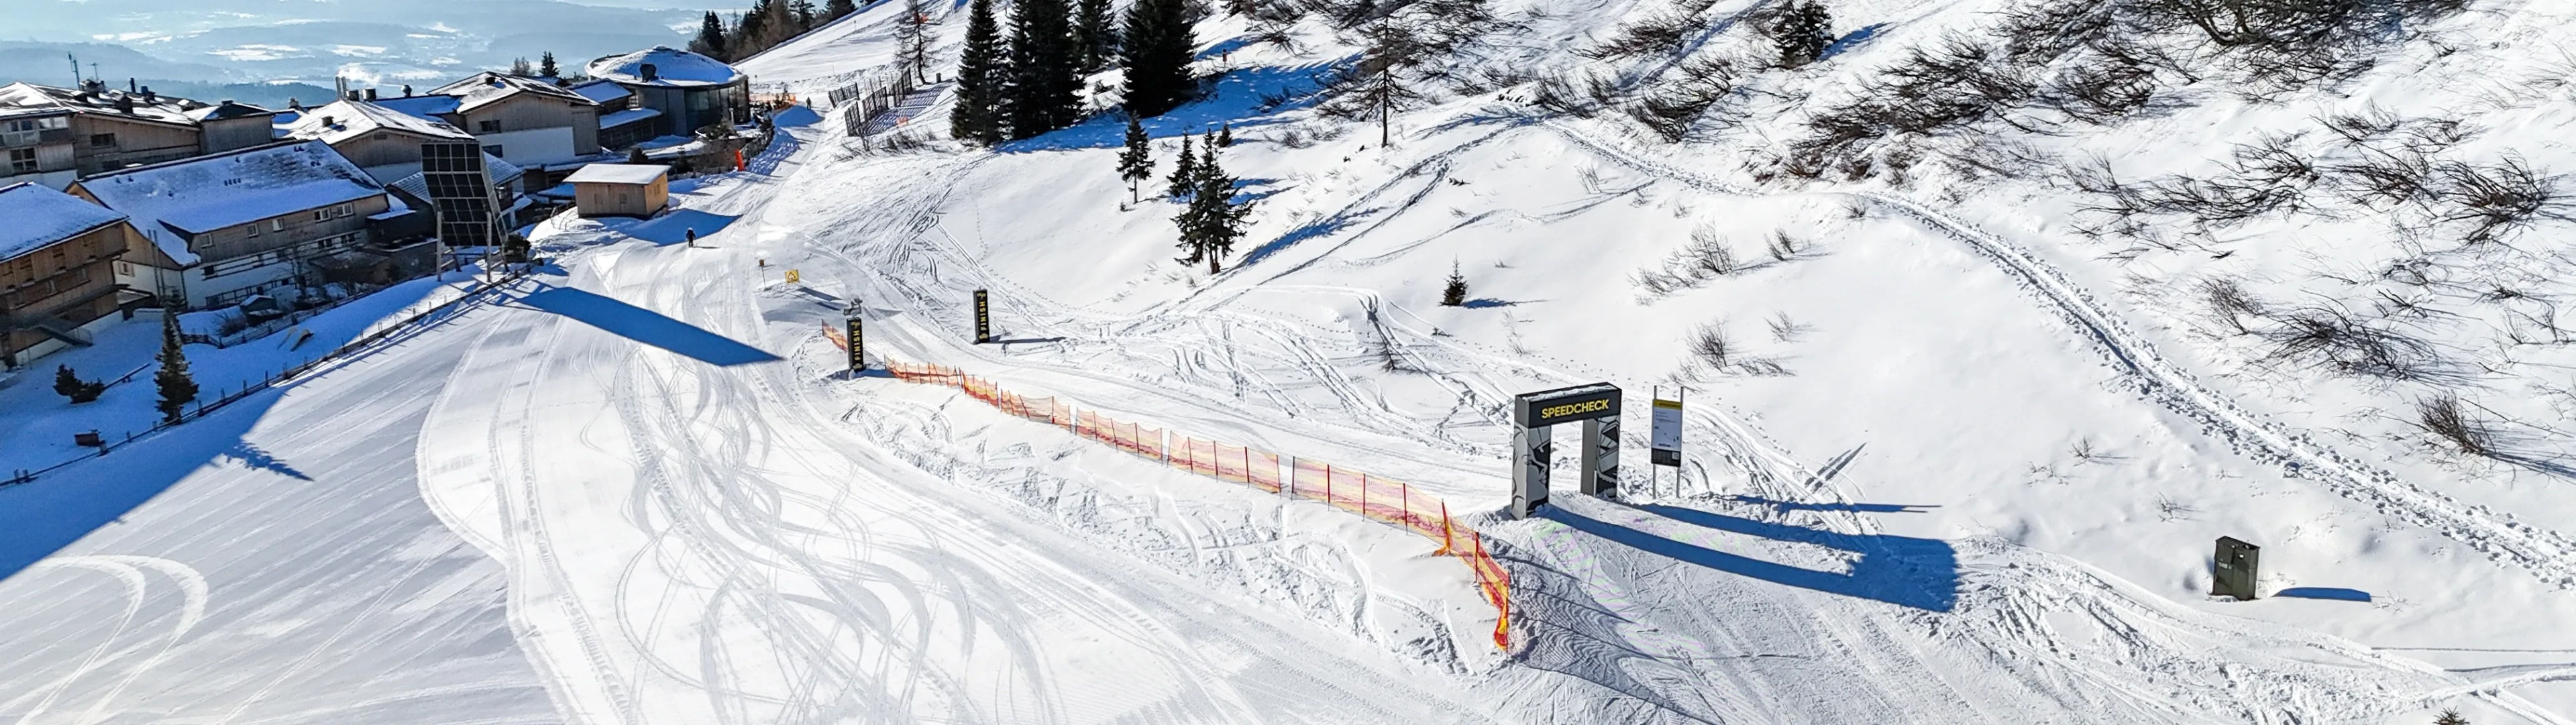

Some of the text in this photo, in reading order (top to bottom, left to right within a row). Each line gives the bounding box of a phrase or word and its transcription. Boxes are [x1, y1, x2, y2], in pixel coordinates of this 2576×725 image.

[979, 301, 987, 331] FINISH
[853, 330, 861, 361] FINISH
[1542, 399, 1609, 419] SPEEDCHECK
